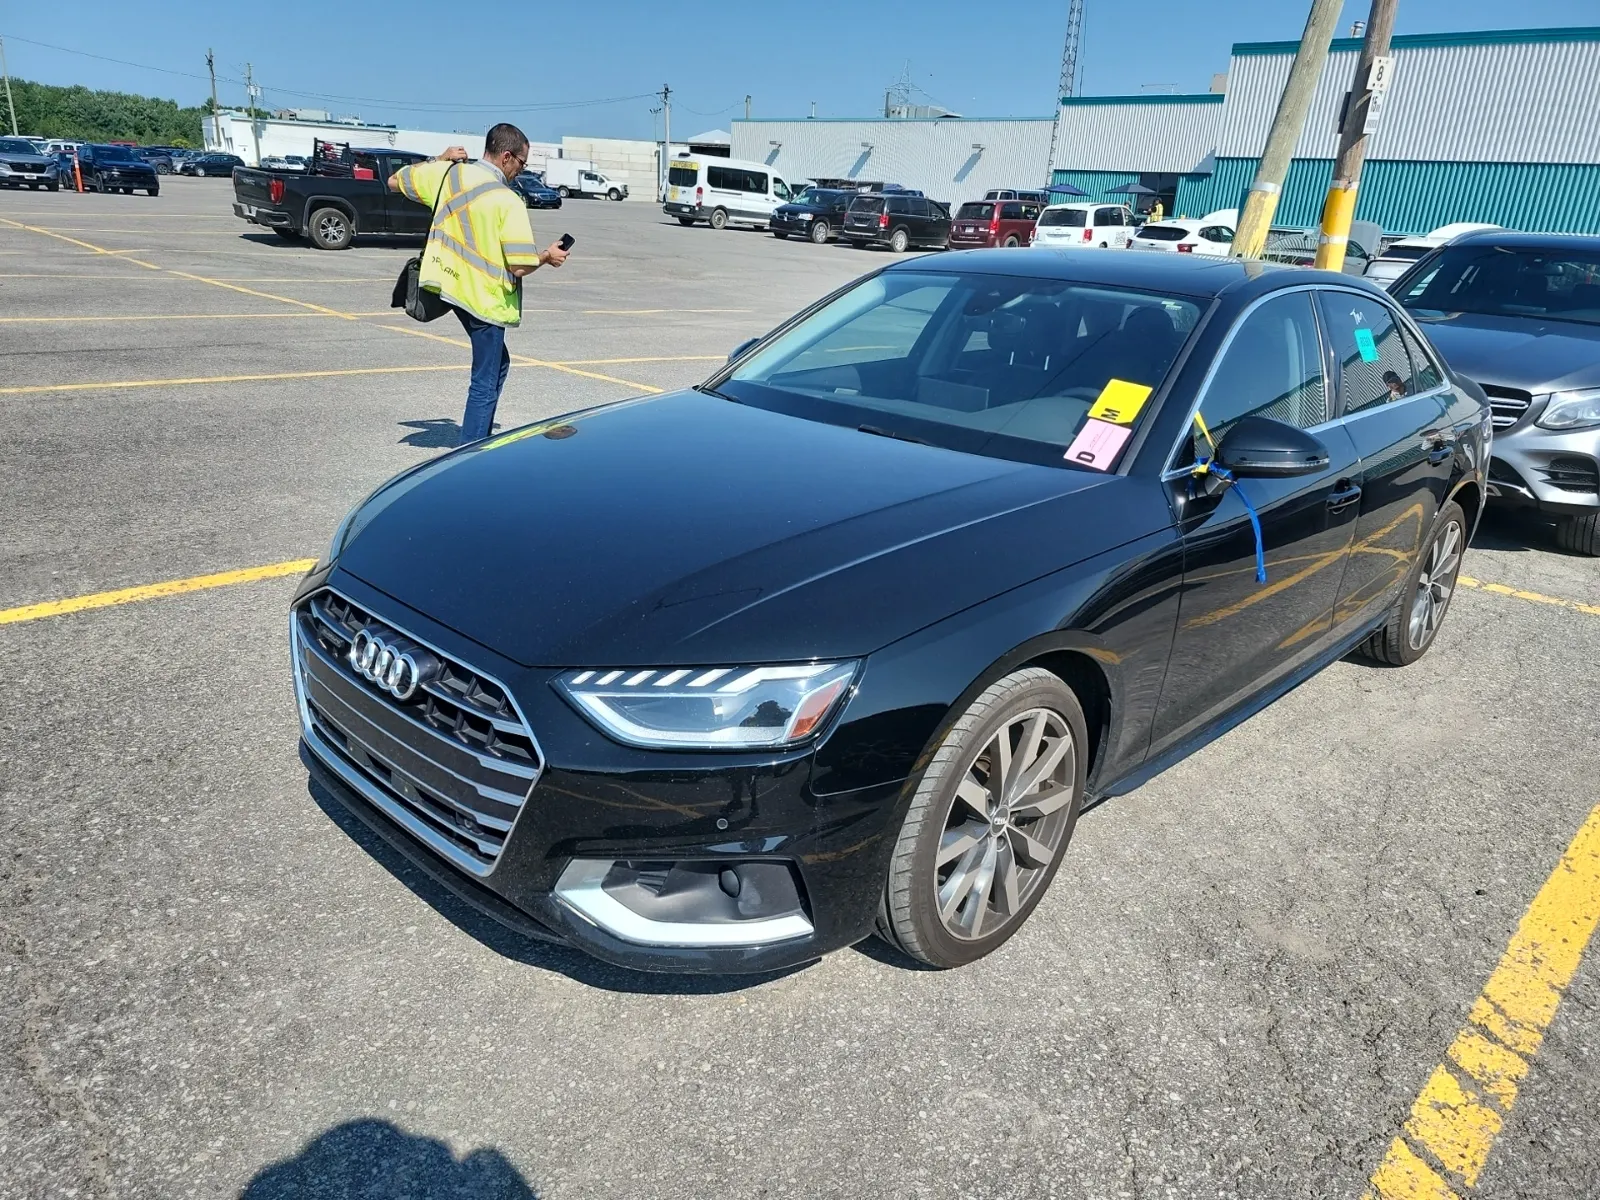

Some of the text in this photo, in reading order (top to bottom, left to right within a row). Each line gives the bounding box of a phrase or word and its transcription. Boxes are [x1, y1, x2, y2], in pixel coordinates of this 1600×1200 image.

[1376, 65, 1384, 81] 8
[1100, 407, 1121, 421] M
[1075, 450, 1096, 464] D
